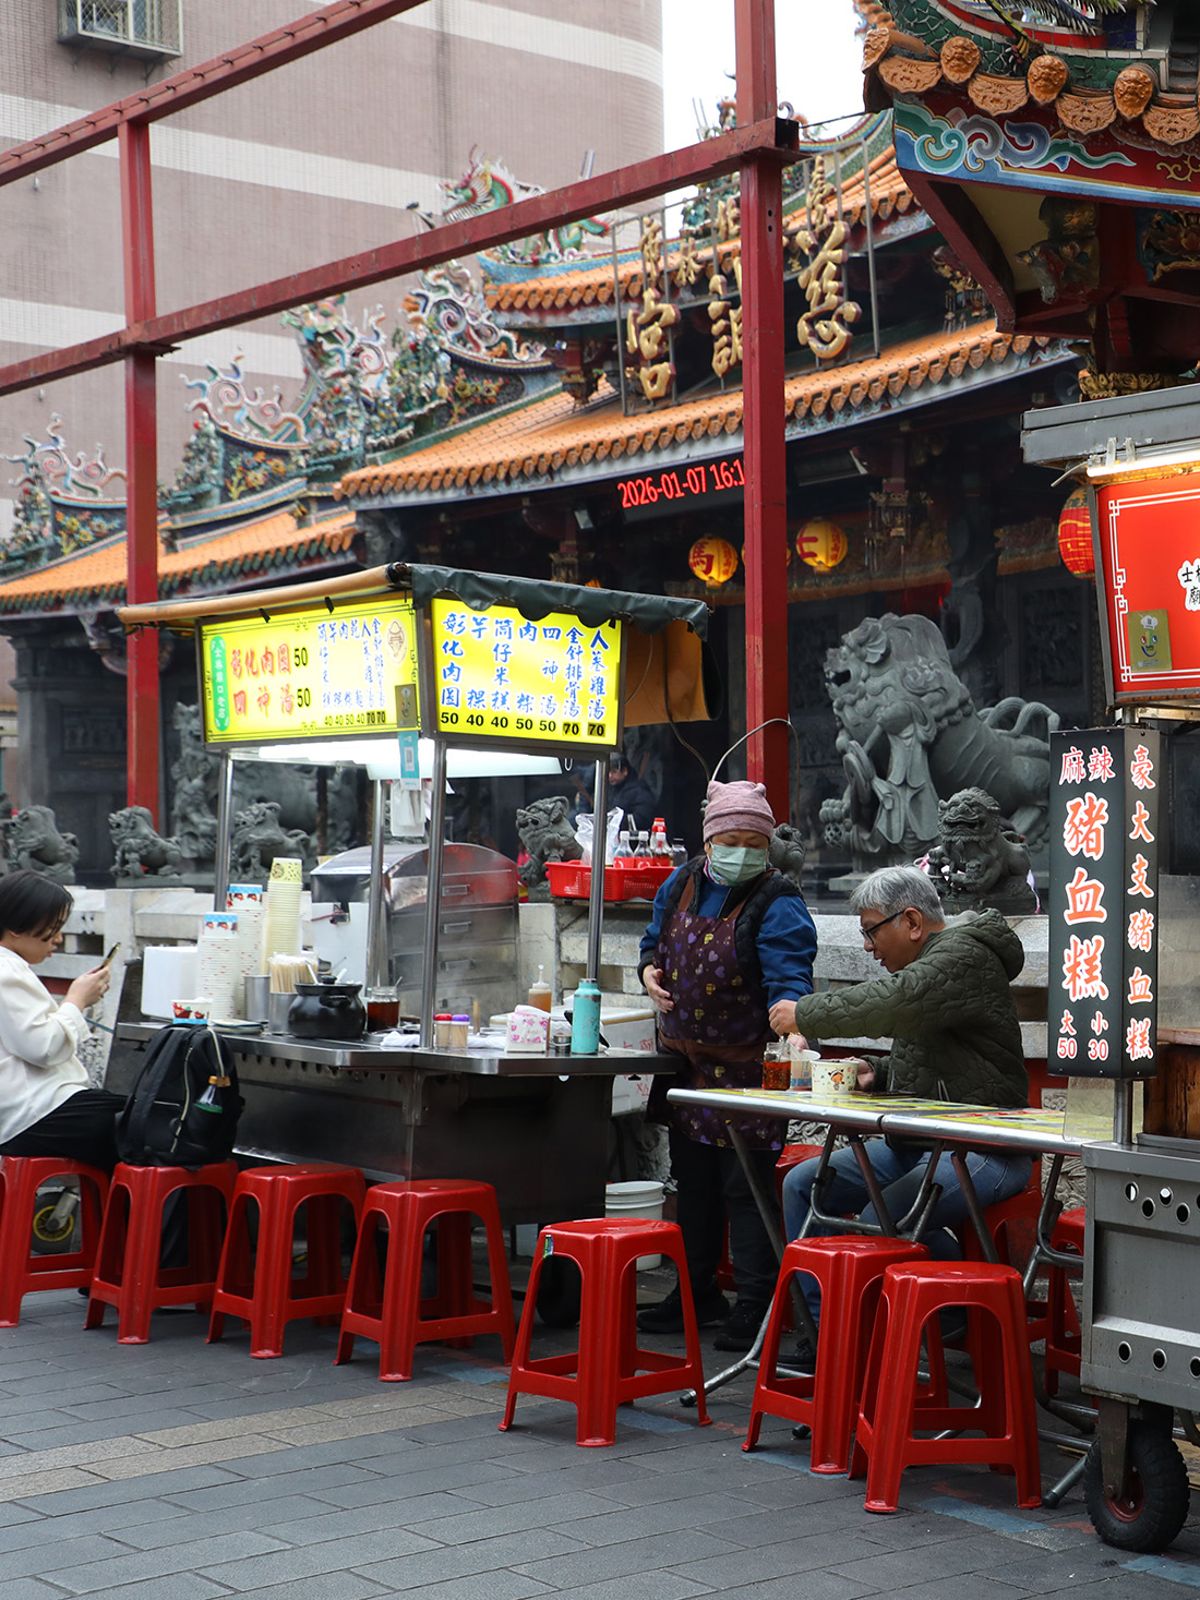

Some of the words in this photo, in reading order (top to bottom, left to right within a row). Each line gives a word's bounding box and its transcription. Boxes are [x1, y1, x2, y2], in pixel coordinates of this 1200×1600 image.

[617, 466, 708, 508] 2026-01-07
[294, 647, 308, 667] 50
[442, 613, 467, 708] 彰化肉圓
[492, 619, 512, 711] 筒仔米糕
[540, 627, 561, 716] 四神湯
[564, 627, 584, 718] 金針排骨湯
[297, 687, 310, 707] 50
[367, 712, 376, 724] 70
[376, 711, 386, 723] 70
[441, 712, 459, 725] 50
[466, 714, 484, 727] 40
[491, 716, 509, 729] 40
[516, 718, 533, 731] 50
[539, 720, 556, 732] 50
[563, 723, 580, 735] 70
[588, 723, 605, 736] 70
[1058, 745, 1116, 786] 麻辣
[1062, 791, 1109, 1003] 豬血糕
[1125, 744, 1155, 1060] 豪大支豬血糕
[1060, 1009, 1077, 1036] 大
[1091, 1010, 1108, 1035] 小
[1057, 1037, 1077, 1059] 50
[1089, 1038, 1108, 1061] 30
